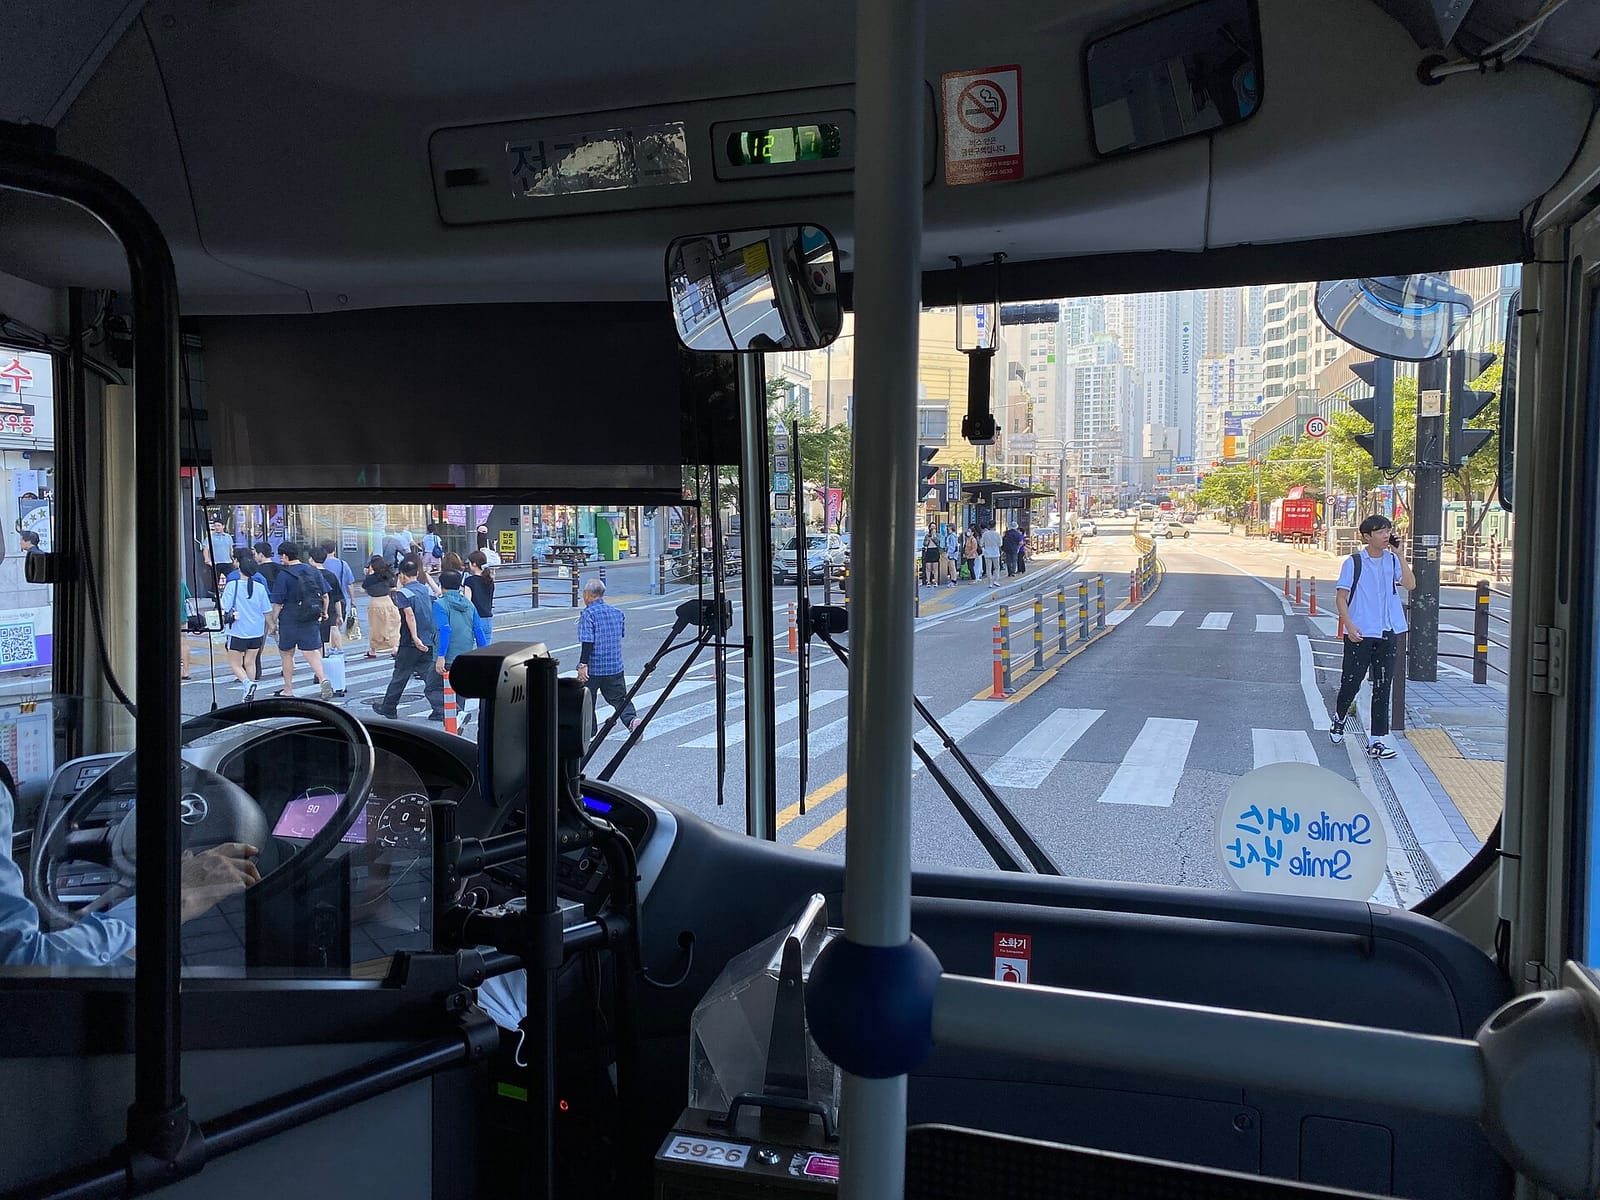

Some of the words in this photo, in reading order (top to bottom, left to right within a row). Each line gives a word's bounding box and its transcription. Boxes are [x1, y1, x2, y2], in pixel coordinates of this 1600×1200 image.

[1182, 338, 1190, 376] HANSHIN
[1, 358, 32, 393] 수
[1311, 422, 1323, 433] 50
[306, 804, 320, 814] 90
[401, 812, 410, 822] 0
[998, 936, 1026, 950] 소화기
[672, 1142, 743, 1163] 5926
